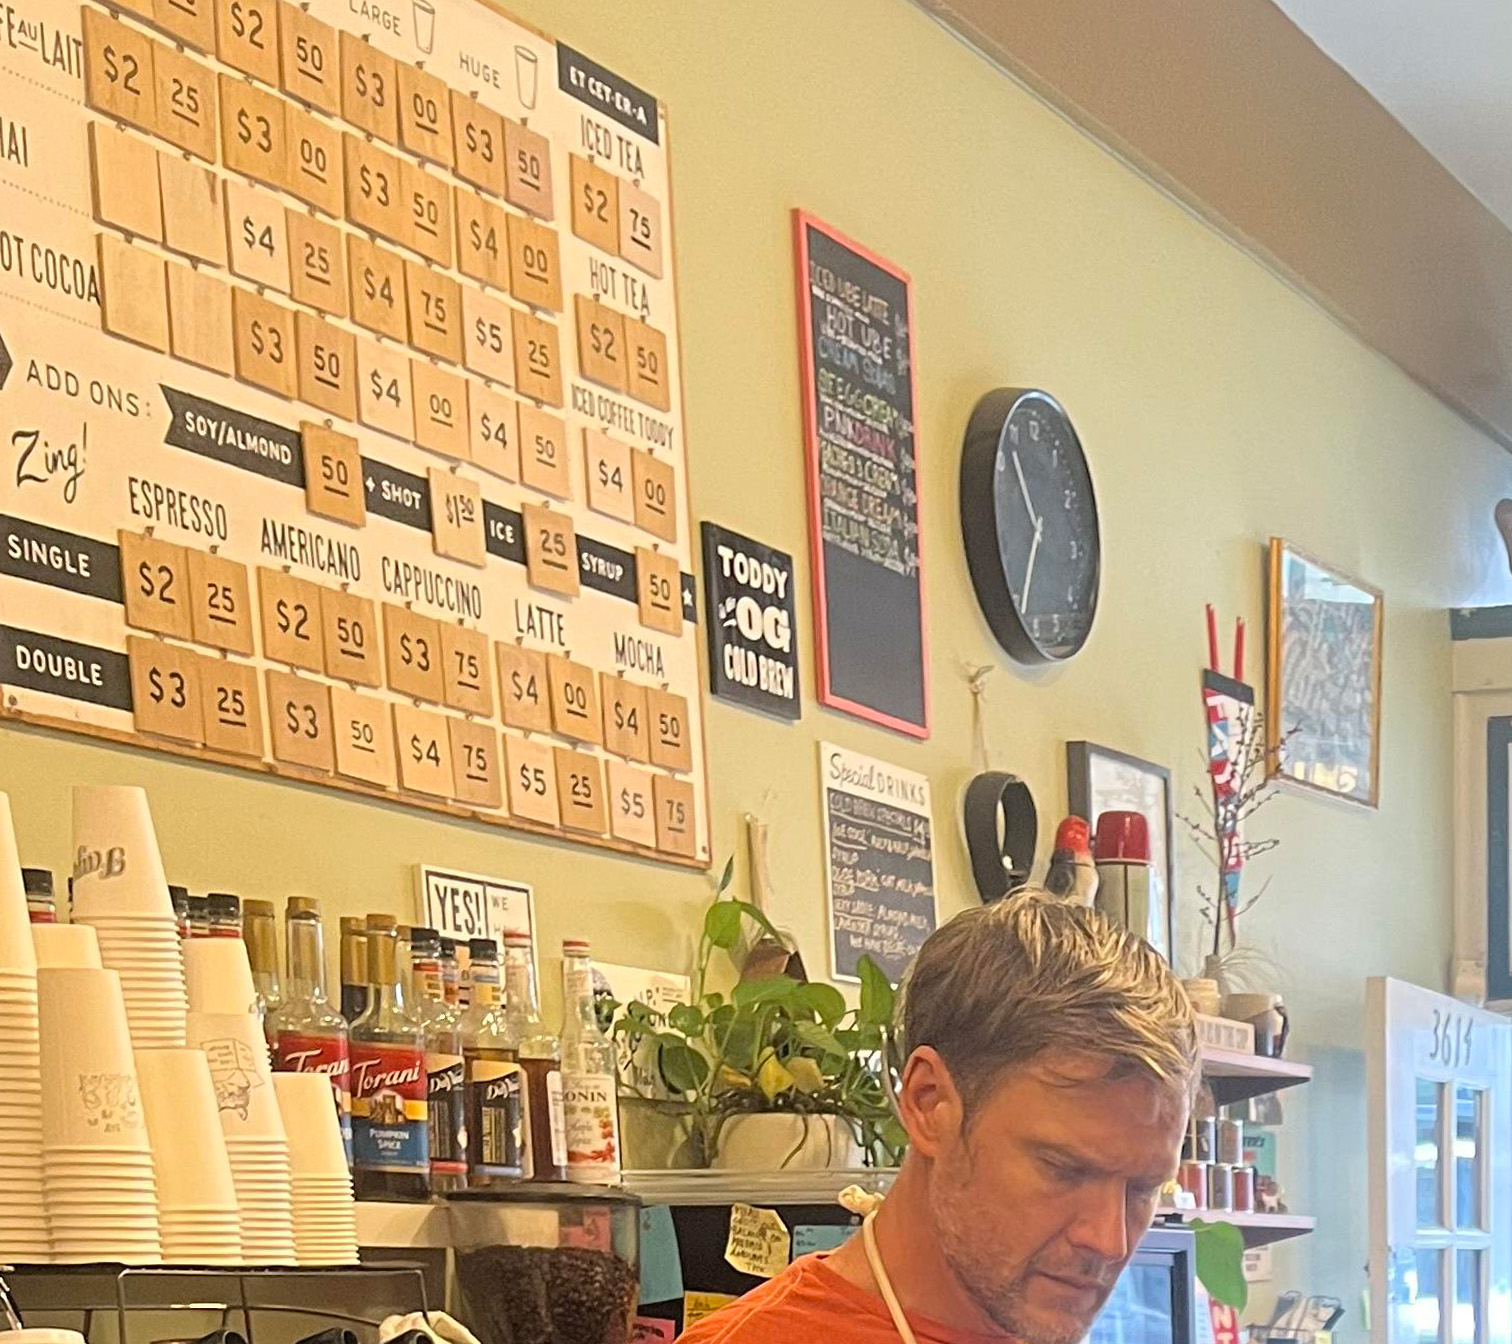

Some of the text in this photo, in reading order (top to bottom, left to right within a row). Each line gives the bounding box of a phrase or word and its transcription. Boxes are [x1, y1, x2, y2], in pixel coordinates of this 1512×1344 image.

[232, 2, 323, 71] $2 50
[349, 0, 401, 36] LARGE
[40, 22, 83, 80] LAIT
[459, 51, 501, 89] HUGE
[103, 45, 200, 113] $2 25
[355, 64, 438, 124] $3 00
[570, 66, 586, 90] ET
[238, 108, 326, 172] $3 00
[466, 122, 540, 180] $3 50
[580, 114, 645, 181] ICED TEA
[360, 164, 438, 225] $3 50
[584, 183, 651, 239] $2 75
[243, 216, 330, 275] $4 25
[470, 219, 547, 273] $4 00
[31, 242, 101, 307] COCOA
[364, 267, 446, 323] $4 75
[589, 256, 651, 317] HOT TEA
[251, 320, 340, 379] $3 50
[475, 317, 550, 369] $5 25
[590, 323, 658, 376] $2 50
[826, 303, 892, 360] HOT UBE
[27, 359, 151, 418] ADD ONS:
[371, 368, 452, 419] $4 00
[599, 393, 635, 436] COFFEE
[11, 421, 88, 504] Zing!
[184, 411, 292, 466] SOY/ALMOND
[481, 414, 556, 459] $4 50
[321, 456, 349, 486] 50
[382, 479, 422, 511] SHOT
[599, 459, 665, 507] $4 00
[128, 476, 228, 541] ESPRESSO
[490, 520, 515, 543] ICE
[8, 534, 91, 578] SINGLE
[260, 517, 361, 583] AMERICANO
[541, 529, 566, 557] 25
[581, 552, 624, 582] SYRUP
[139, 561, 235, 613] $2 25
[382, 556, 482, 620] CAPPUCCINO
[650, 575, 671, 601] 50
[717, 544, 788, 599] TODDY
[277, 599, 364, 648] $2 50
[515, 599, 565, 647] LATTE
[735, 596, 791, 653] OG
[16, 644, 103, 686] DOUBLE
[400, 632, 479, 679] $3 75
[613, 632, 665, 678] MOCHA
[724, 643, 794, 699] COLD BREW
[149, 666, 245, 716] $3 25
[512, 671, 587, 710] $4 00
[287, 701, 374, 745] $3 50
[615, 700, 680, 739] $4 50
[411, 734, 487, 772] $4 75
[520, 763, 592, 800] $5 25
[620, 787, 686, 824] $5 75
[829, 752, 926, 807] Special DRINKS
[435, 883, 483, 936] YES!
[491, 895, 508, 911] WE
[285, 1049, 349, 1077] Toran
[352, 1059, 420, 1098] Torani
